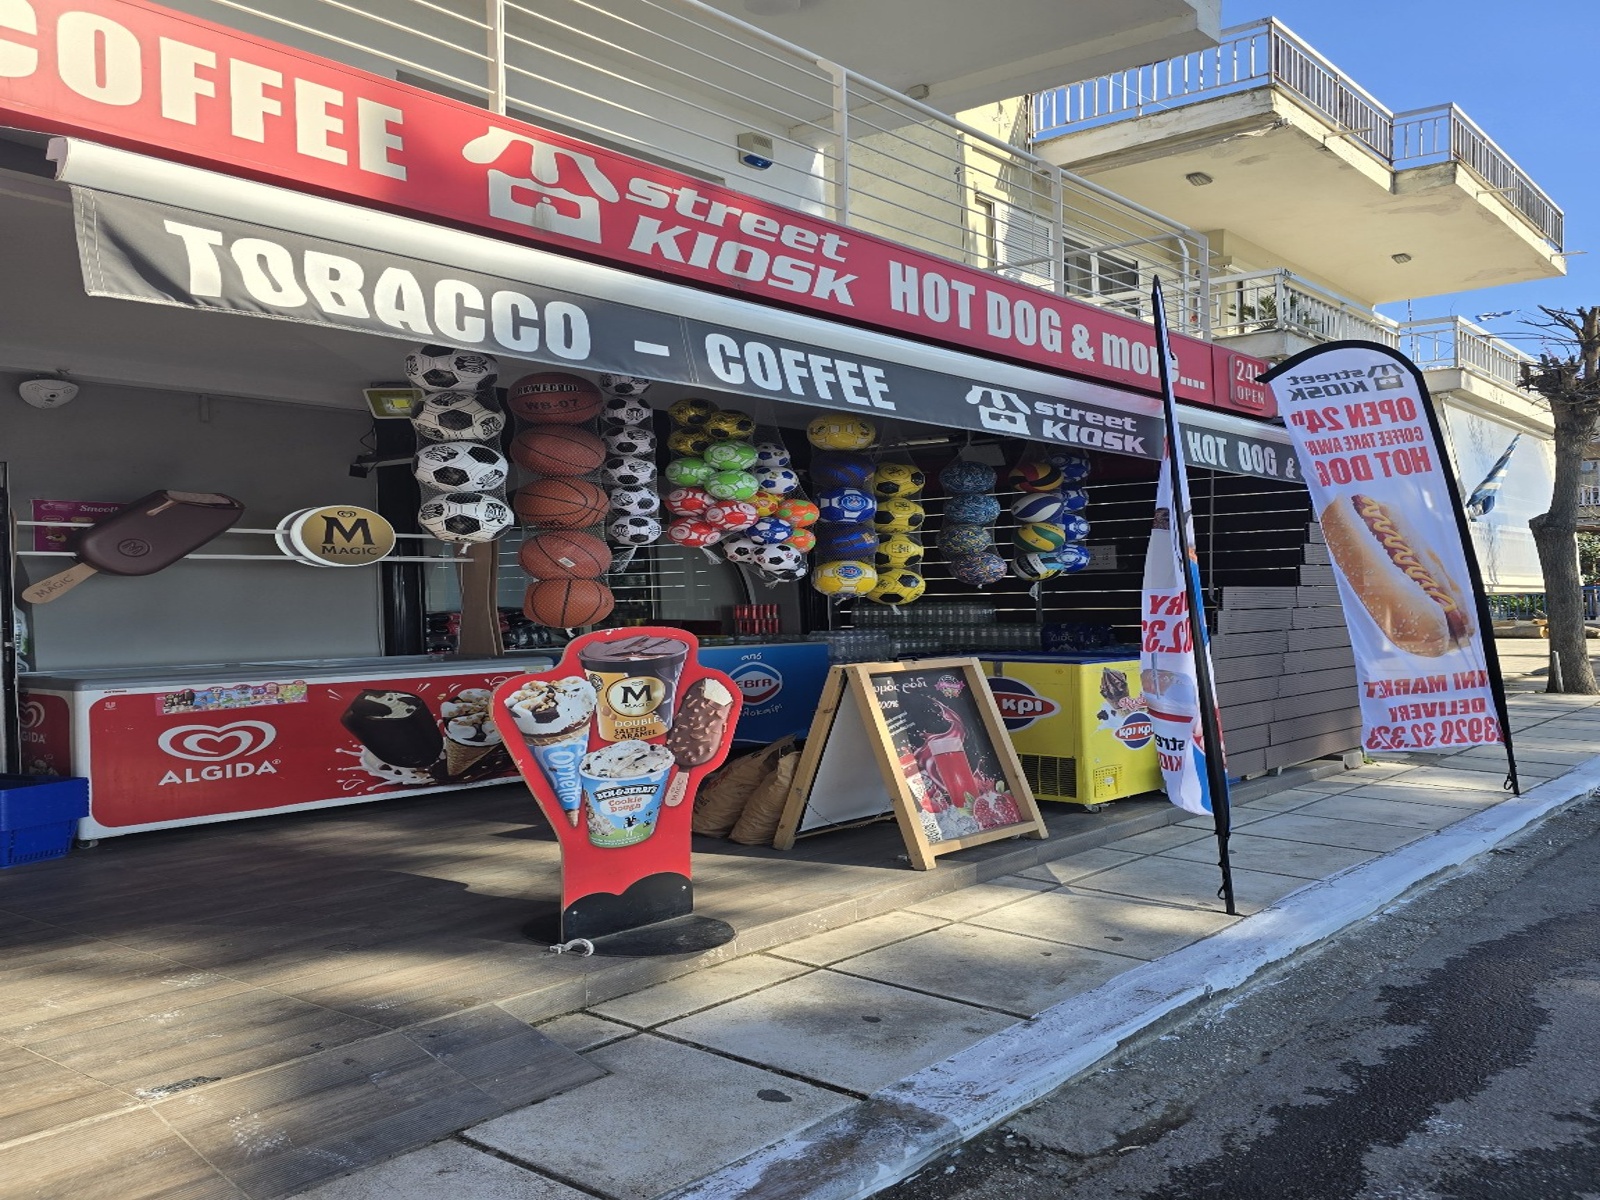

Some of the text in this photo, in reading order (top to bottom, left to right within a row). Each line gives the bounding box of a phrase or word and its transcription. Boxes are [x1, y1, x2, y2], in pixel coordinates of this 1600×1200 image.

[625, 176, 849, 264] street
[627, 217, 859, 307] KIOSK
[164, 220, 591, 360] TOBACCO
[705, 333, 896, 410] COFFEE
[889, 260, 975, 330] HOT
[986, 290, 1062, 354] DOG
[1071, 323, 1095, 362] &
[1236, 360, 1264, 386] 24h
[1237, 386, 1265, 404] OPEN
[1034, 400, 1137, 431] street
[1042, 418, 1148, 456] KIOSK
[1186, 430, 1227, 466] HOT
[1238, 442, 1278, 477] DOG
[1285, 457, 1296, 479] &
[321, 516, 376, 546] M
[321, 545, 380, 556] MAGIC
[34, 574, 74, 598] MAGIC
[621, 685, 652, 703] M
[872, 680, 900, 695] υμός
[613, 729, 658, 739] CARAMEL
[614, 717, 660, 728] DOUBLE
[614, 726, 647, 735] SALTED
[20, 731, 46, 744] GIDA
[608, 796, 643, 807] Cookie
